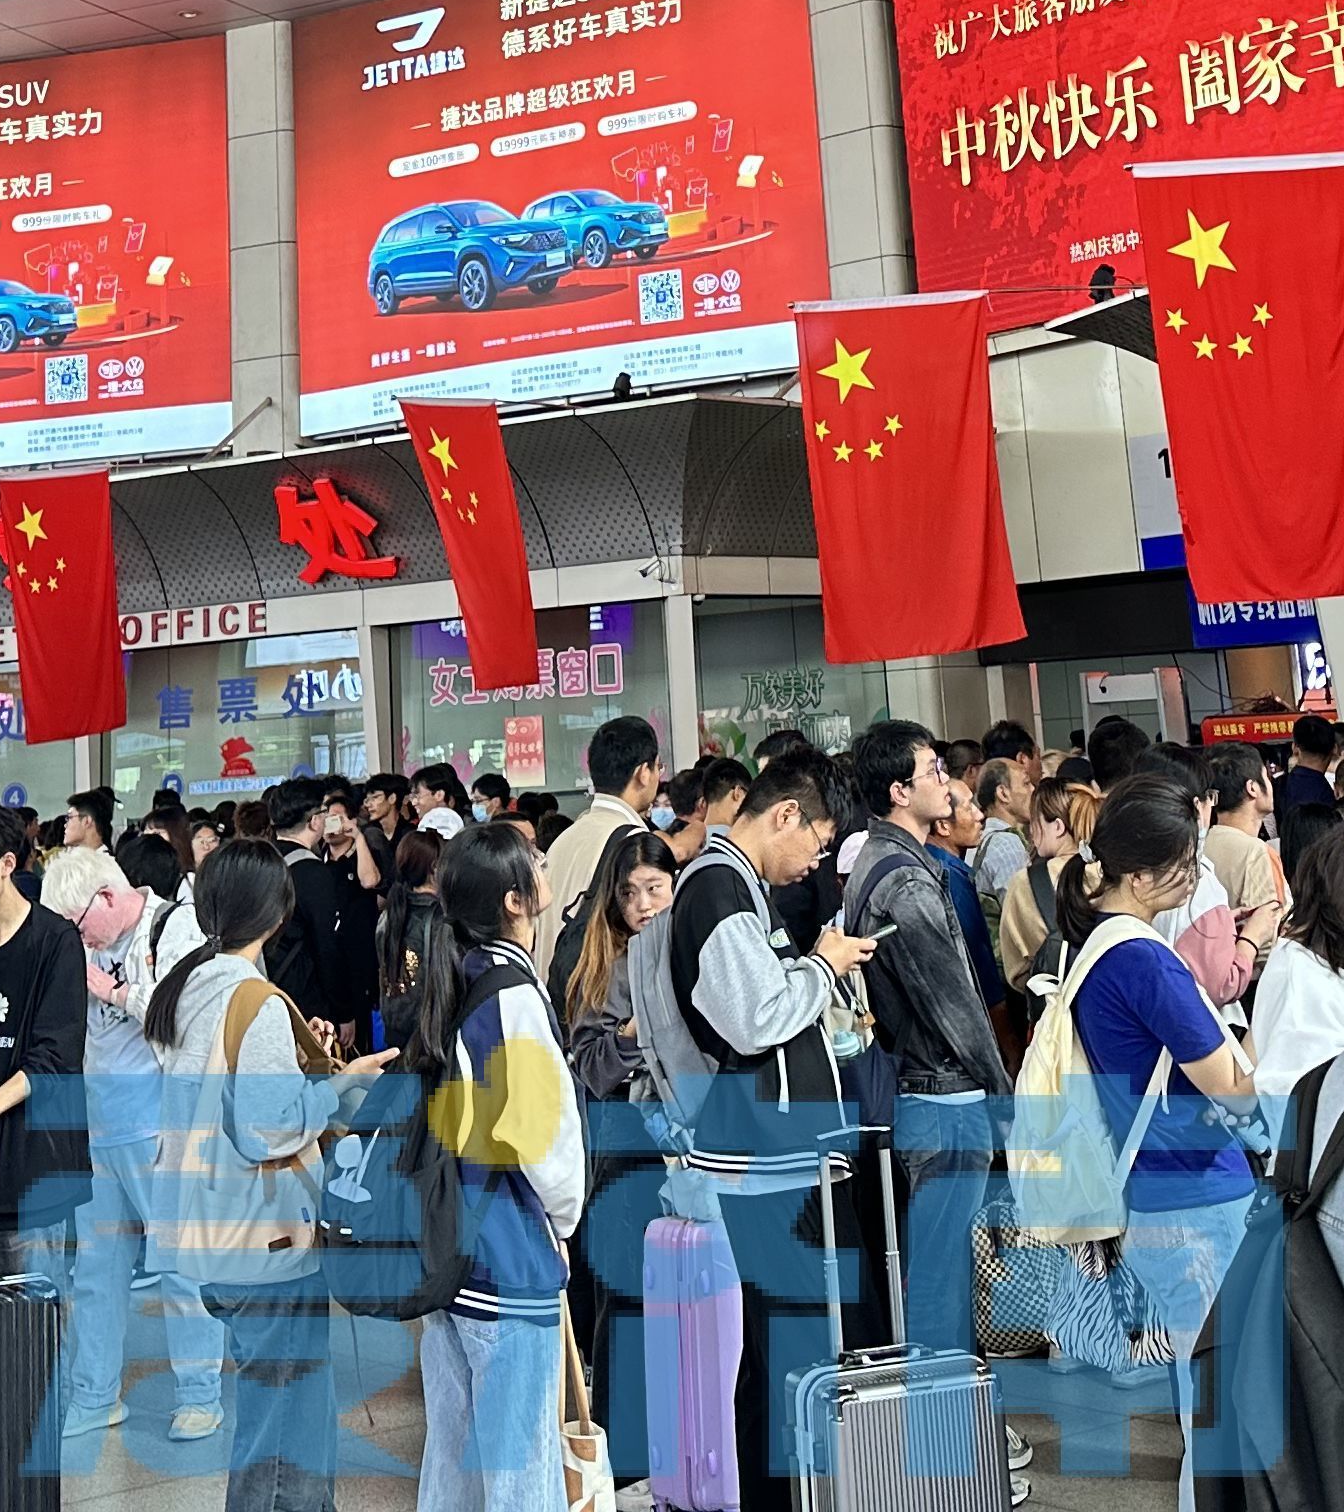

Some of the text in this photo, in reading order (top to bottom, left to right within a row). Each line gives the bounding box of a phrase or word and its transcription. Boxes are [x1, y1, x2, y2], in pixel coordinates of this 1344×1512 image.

[440, 70, 636, 131] 捷达品牌超级狂欢月
[942, 55, 1159, 187] 中秋快乐
[120, 601, 267, 646] OFFICE
[157, 671, 325, 730] 售票处
[8, 791, 20, 806] 4
